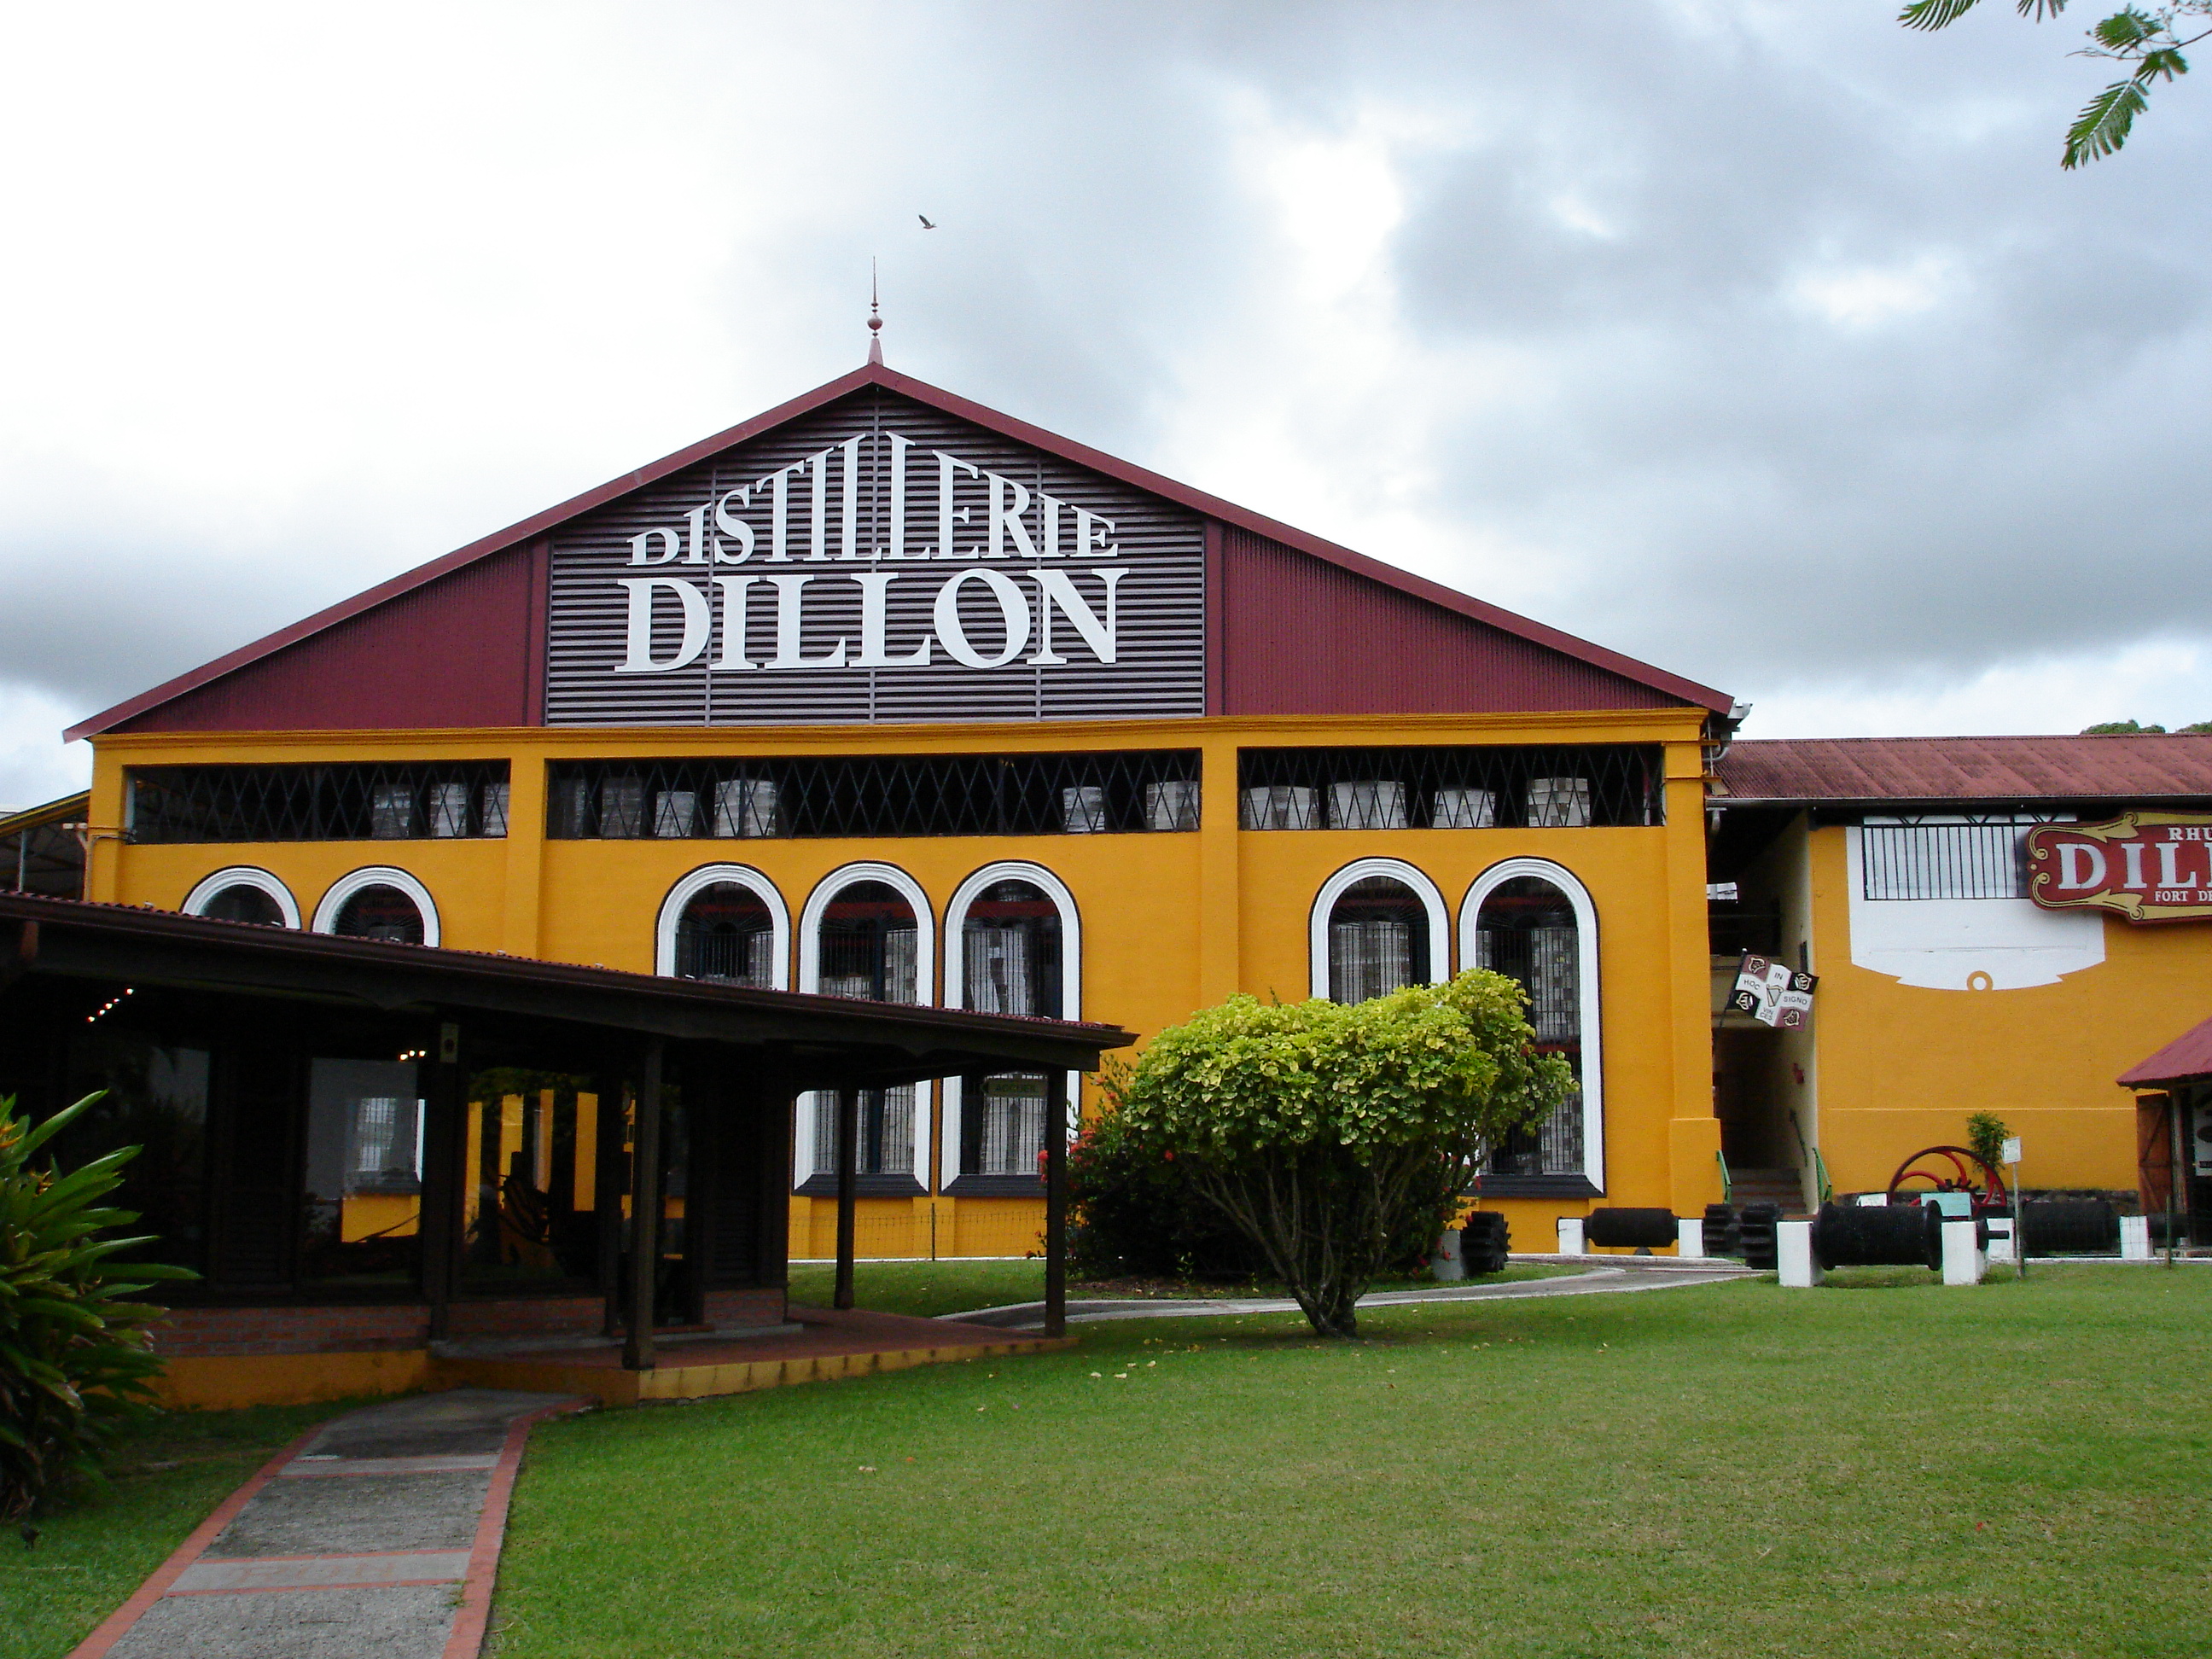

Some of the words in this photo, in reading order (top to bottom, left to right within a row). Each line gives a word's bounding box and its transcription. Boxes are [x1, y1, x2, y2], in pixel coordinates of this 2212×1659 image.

[626, 431, 1118, 567] DISTILLERIE
[614, 568, 1129, 672] DILLON
[2057, 843, 2212, 889] DIL
[2155, 890, 2188, 902] FORT
[1774, 972, 1784, 981] IN
[1743, 979, 1760, 990] HOC
[1784, 996, 1807, 1005] SIGNO
